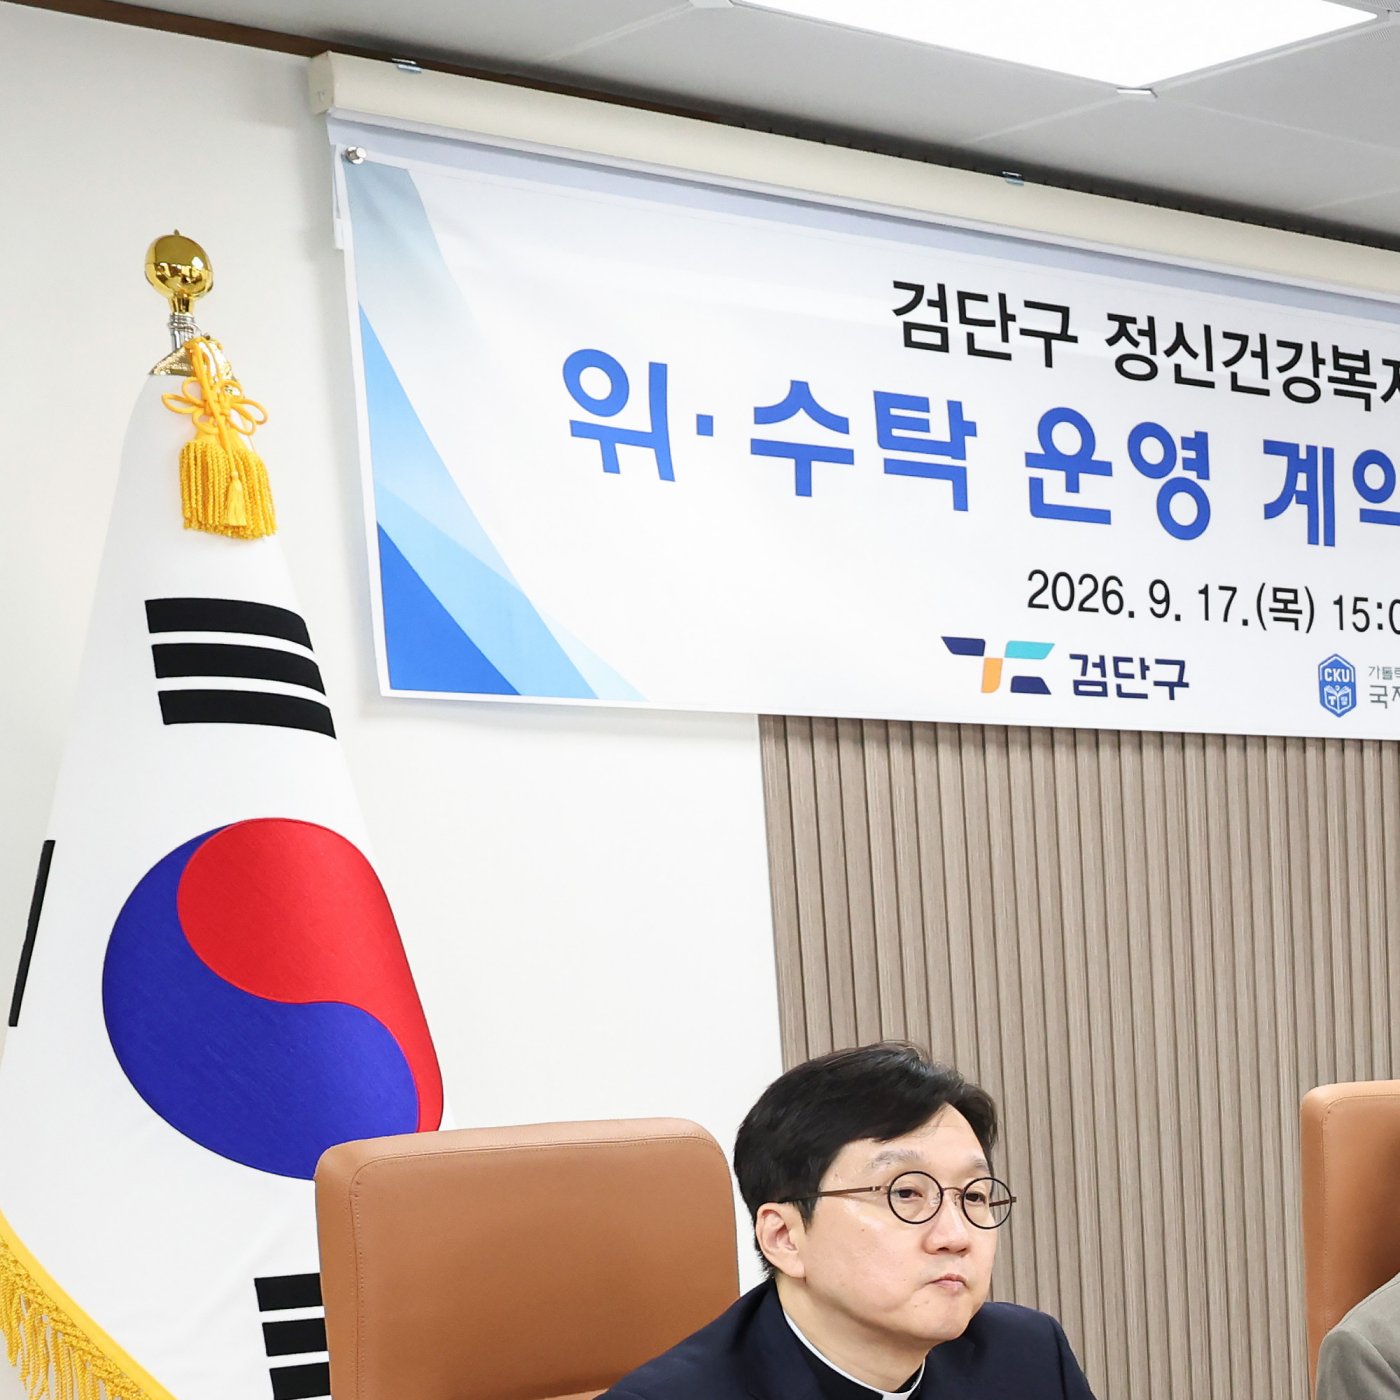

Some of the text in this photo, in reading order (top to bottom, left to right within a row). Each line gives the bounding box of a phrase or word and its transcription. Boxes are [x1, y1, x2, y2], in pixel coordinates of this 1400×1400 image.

[893, 281, 1078, 368] 검단구
[563, 349, 977, 512] 위·수탁
[1025, 407, 1210, 540] 운영
[1028, 570, 1134, 618] 2026.
[1149, 580, 1180, 621] 9.
[1070, 654, 1189, 700] 검단구
[1325, 668, 1350, 683] CKU
